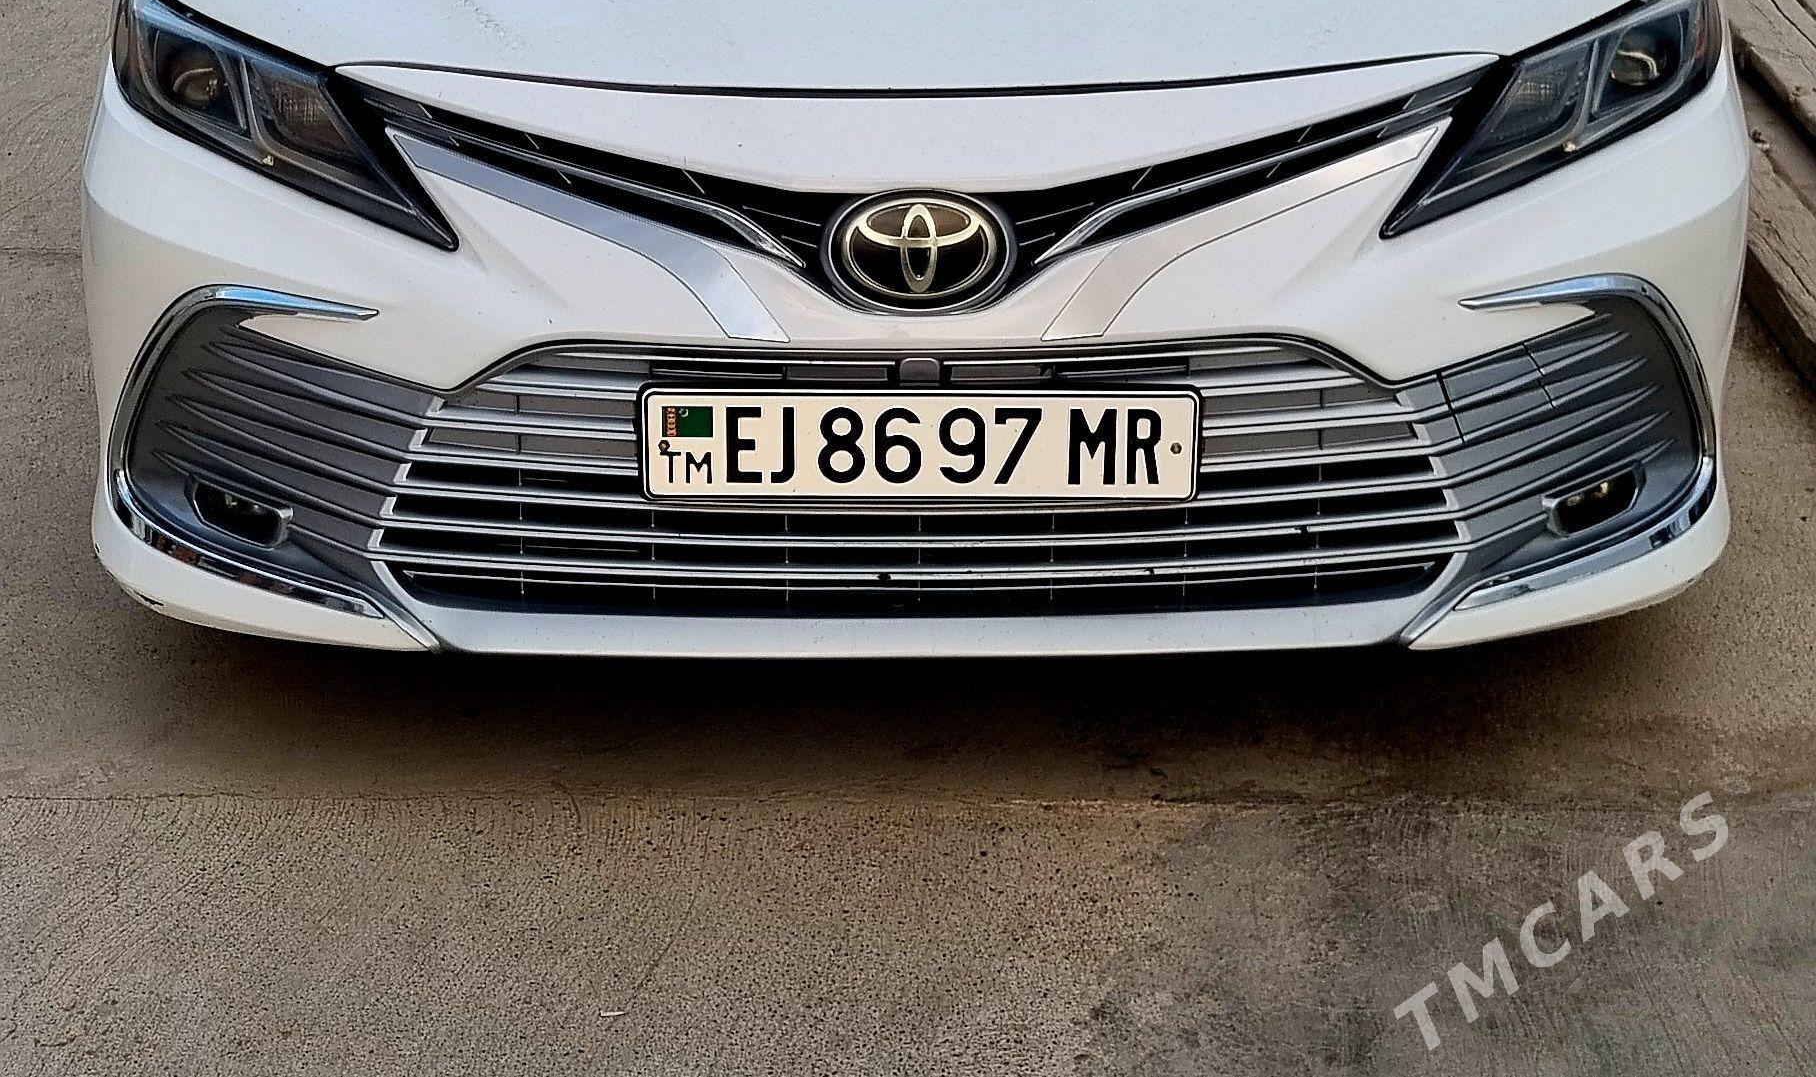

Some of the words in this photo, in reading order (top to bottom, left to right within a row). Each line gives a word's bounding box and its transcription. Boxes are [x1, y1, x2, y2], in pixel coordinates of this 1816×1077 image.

[662, 451, 713, 485] TM
[726, 406, 795, 484] EJ
[1067, 407, 1162, 485] MR
